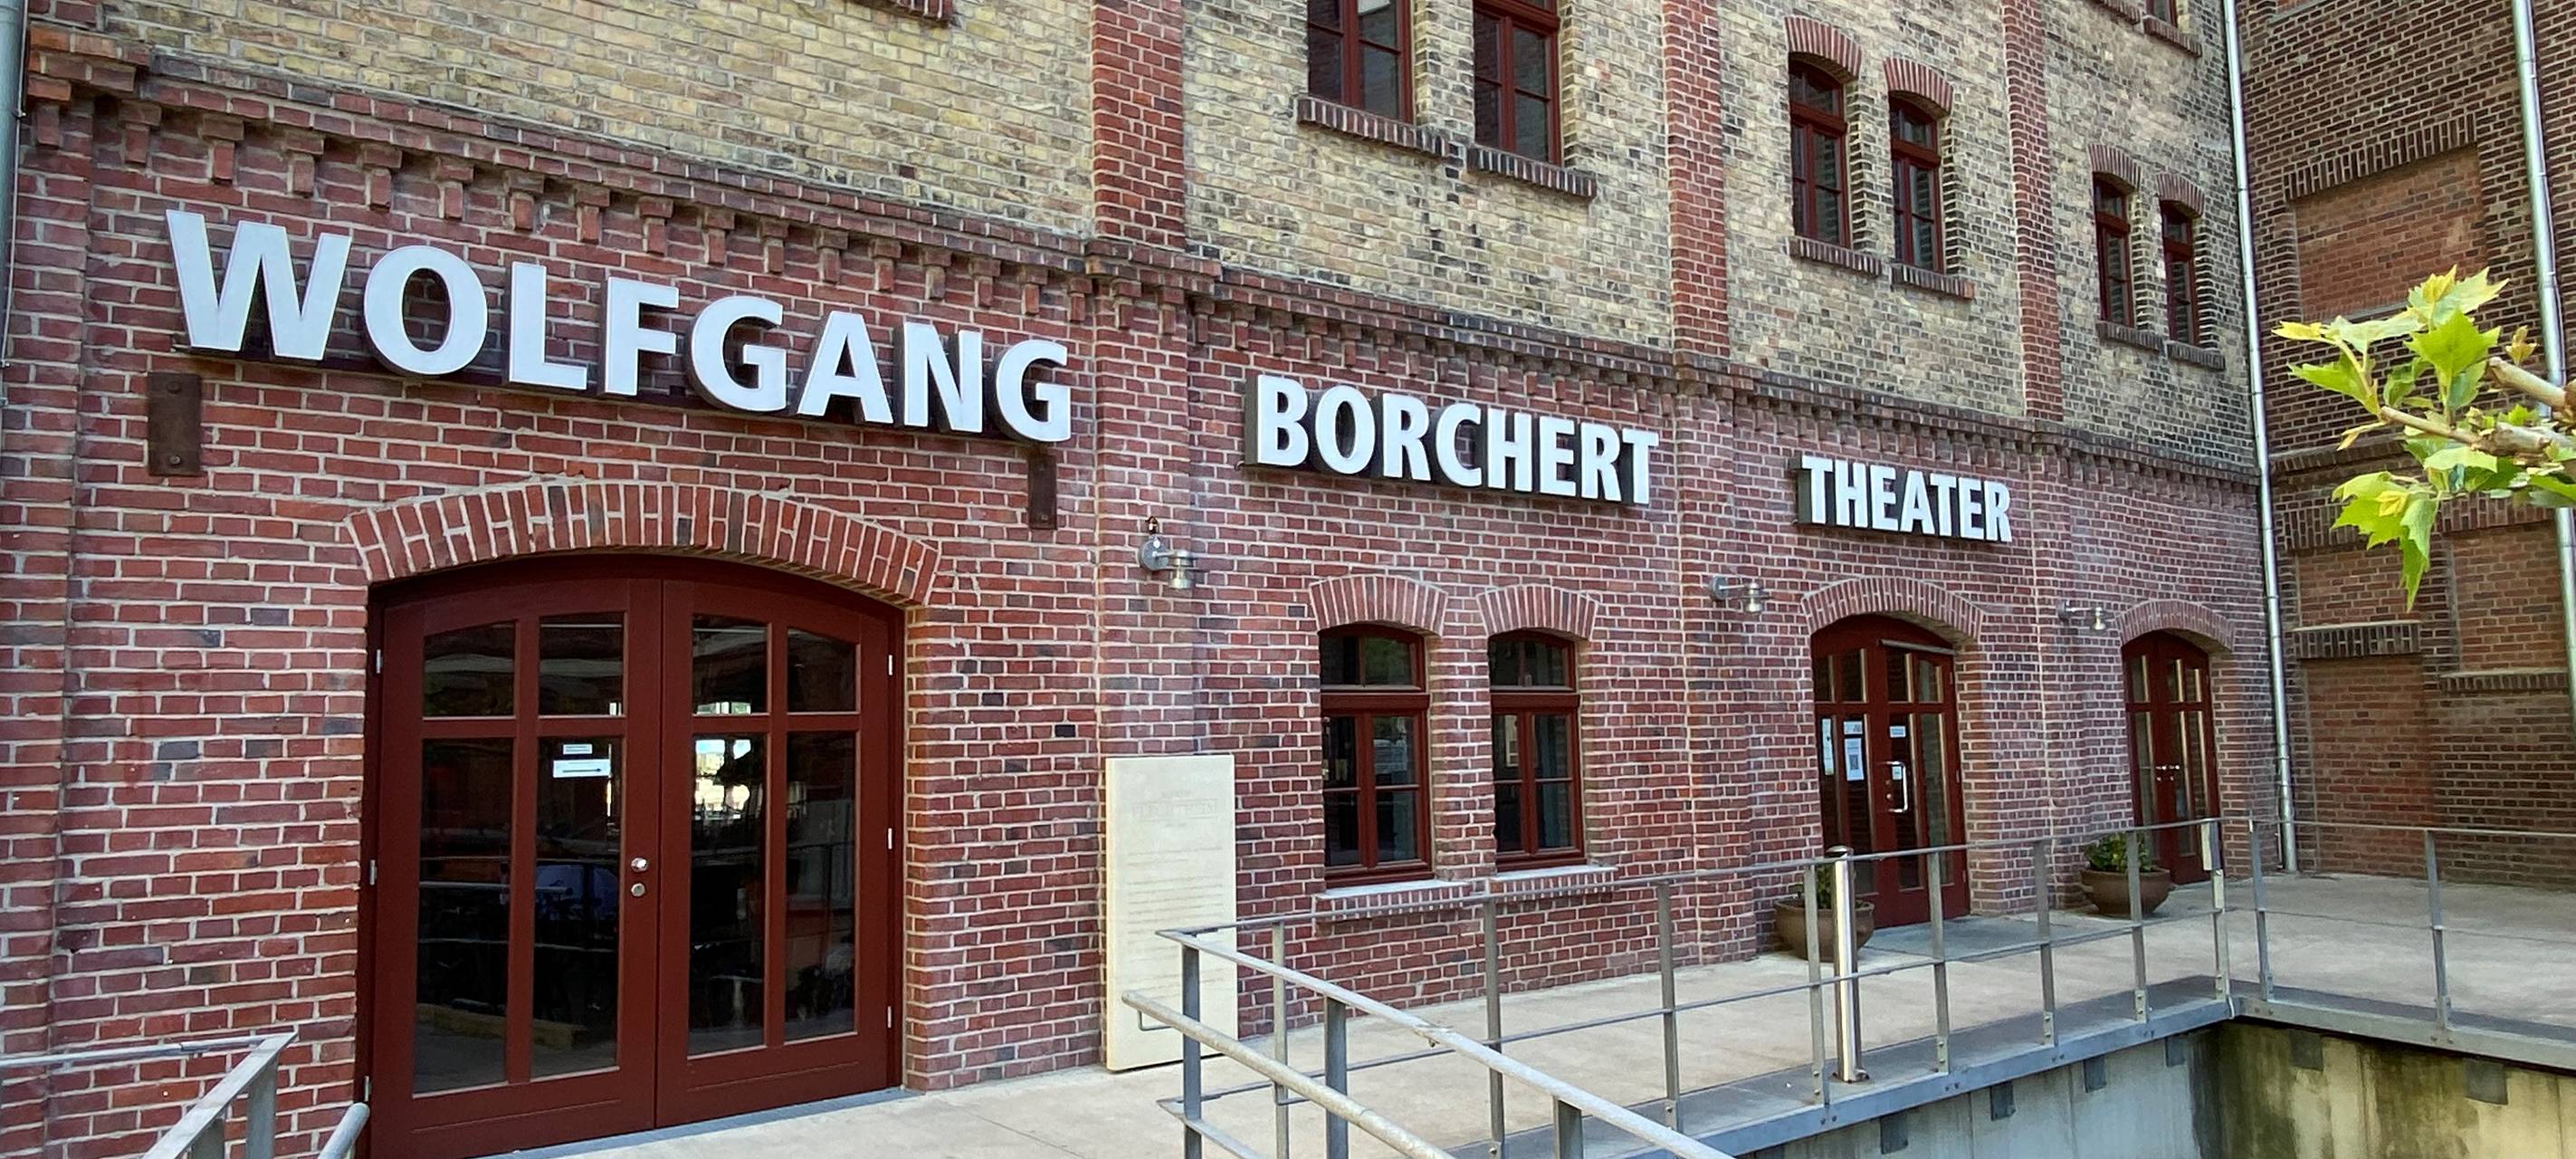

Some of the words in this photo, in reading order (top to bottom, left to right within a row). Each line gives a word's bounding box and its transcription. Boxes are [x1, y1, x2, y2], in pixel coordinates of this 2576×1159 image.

[166, 209, 1071, 442] WOLFGANG
[1257, 374, 1659, 504] BORCHERT
[1801, 455, 2012, 542] THEATER
